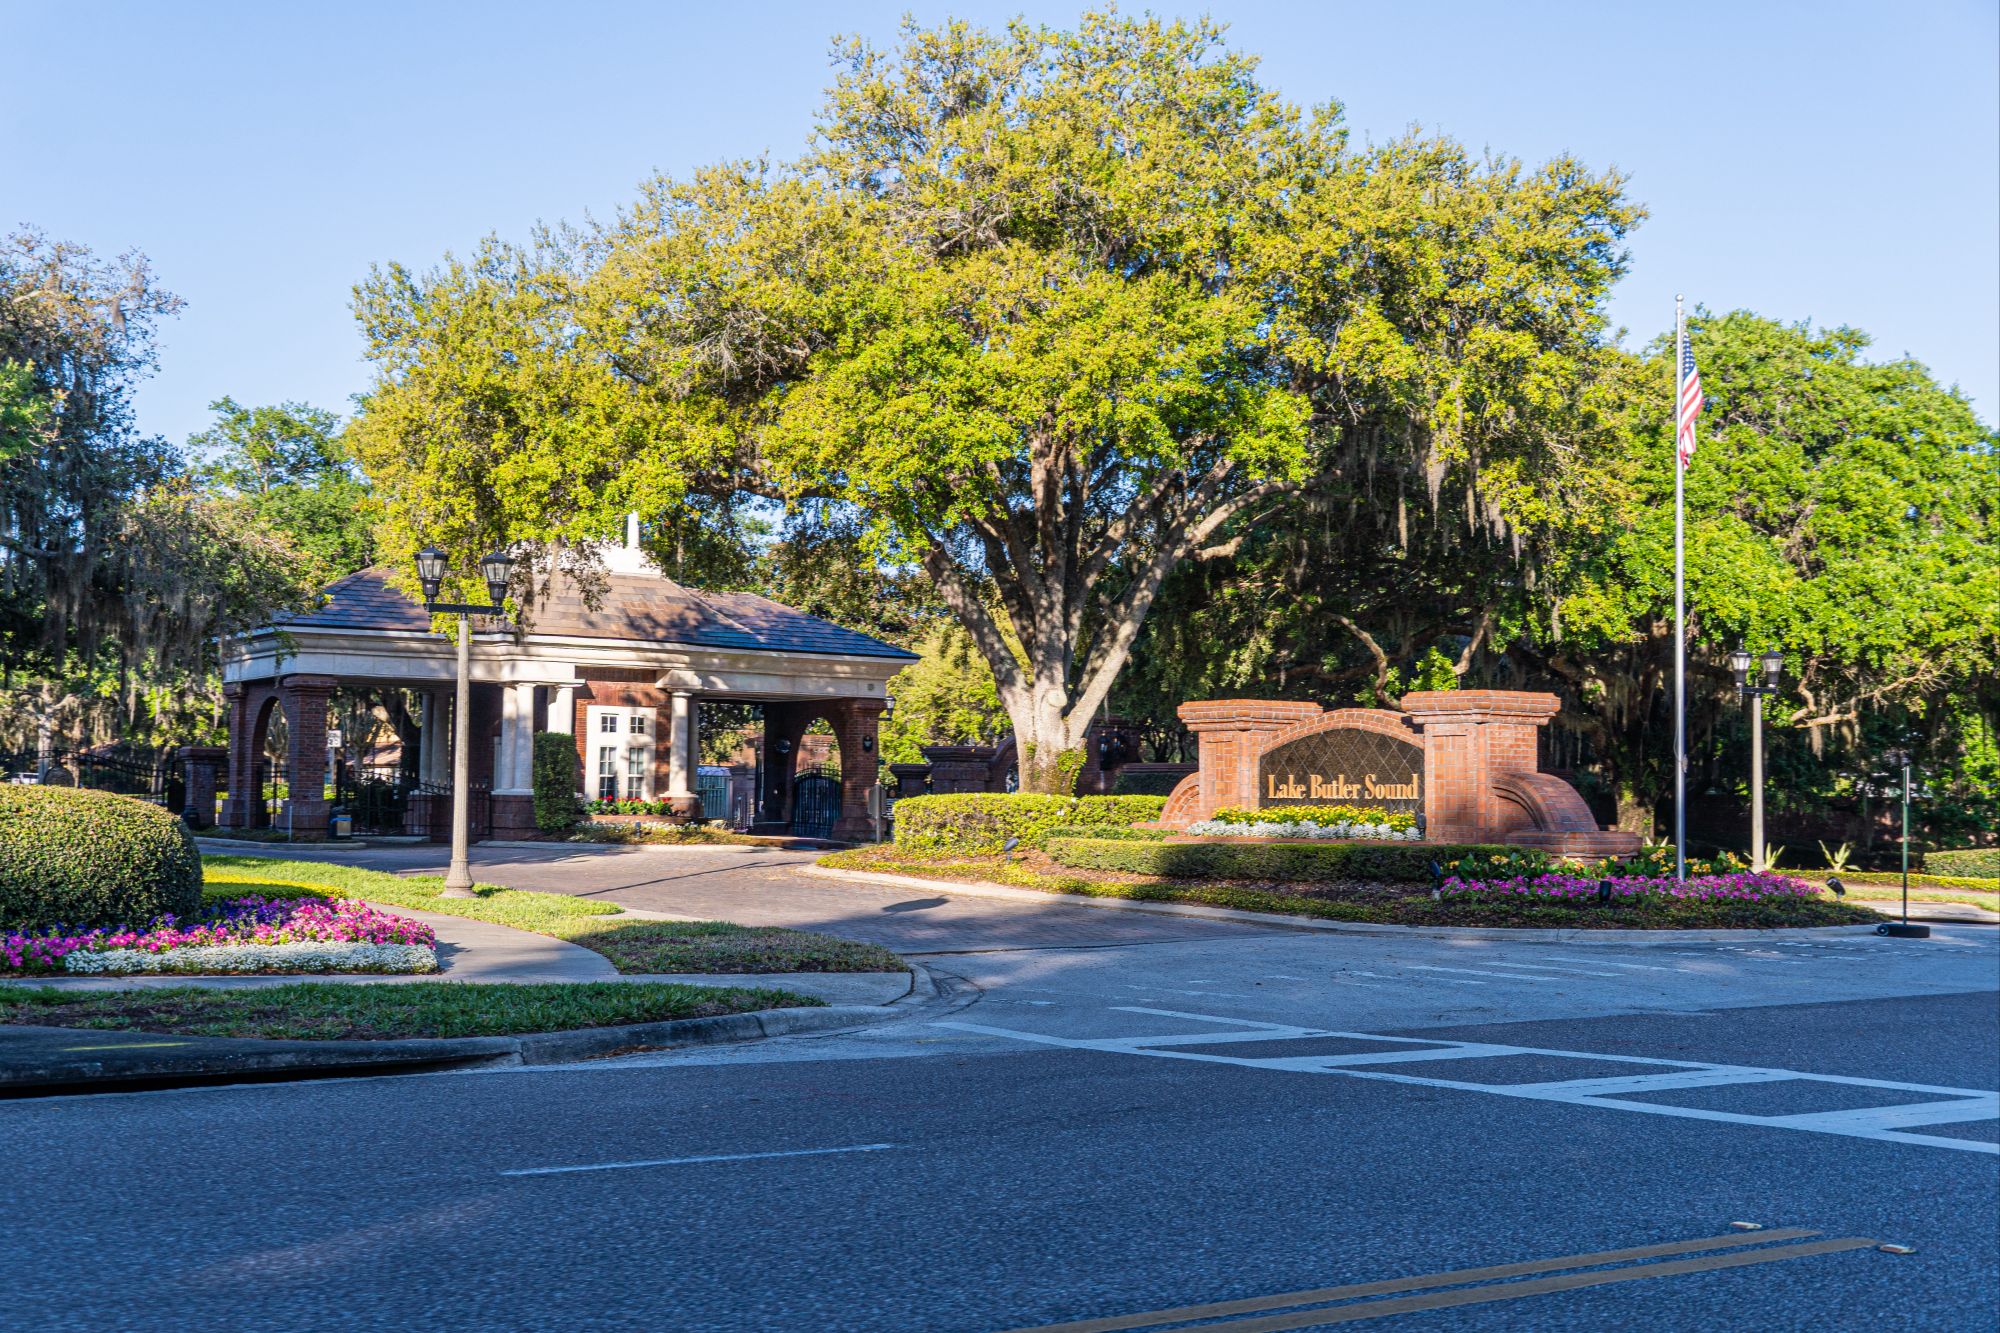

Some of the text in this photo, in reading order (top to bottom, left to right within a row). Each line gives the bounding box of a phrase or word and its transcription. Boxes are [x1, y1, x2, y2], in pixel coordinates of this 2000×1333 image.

[1268, 773, 1419, 799] Lake Butler Sound
